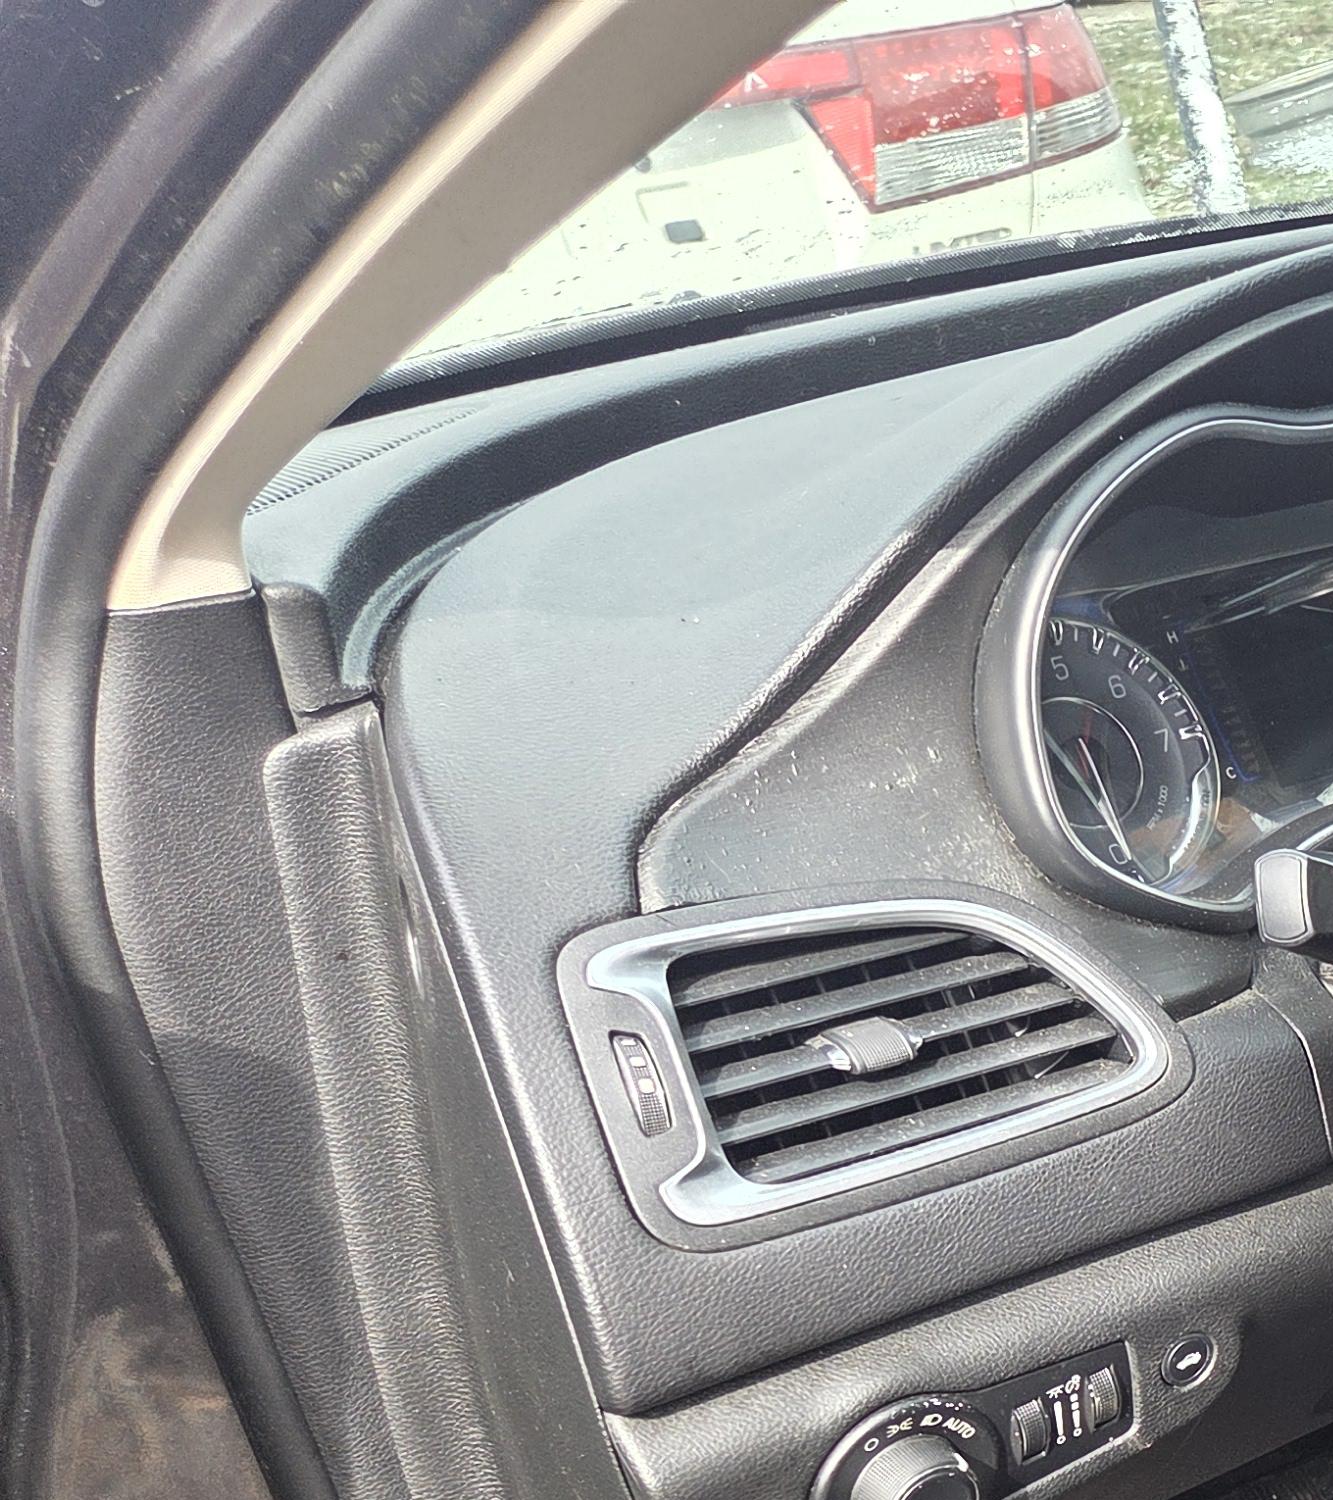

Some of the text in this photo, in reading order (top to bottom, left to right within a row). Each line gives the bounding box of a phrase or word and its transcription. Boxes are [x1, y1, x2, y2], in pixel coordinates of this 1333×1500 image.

[1166, 631, 1180, 645] H
[1050, 655, 1070, 681] 5
[1107, 674, 1127, 699] 6
[1153, 727, 1169, 753] 7
[1225, 766, 1237, 780] C
[1108, 843, 1130, 865] 0
[941, 1416, 976, 1439] AUTO
